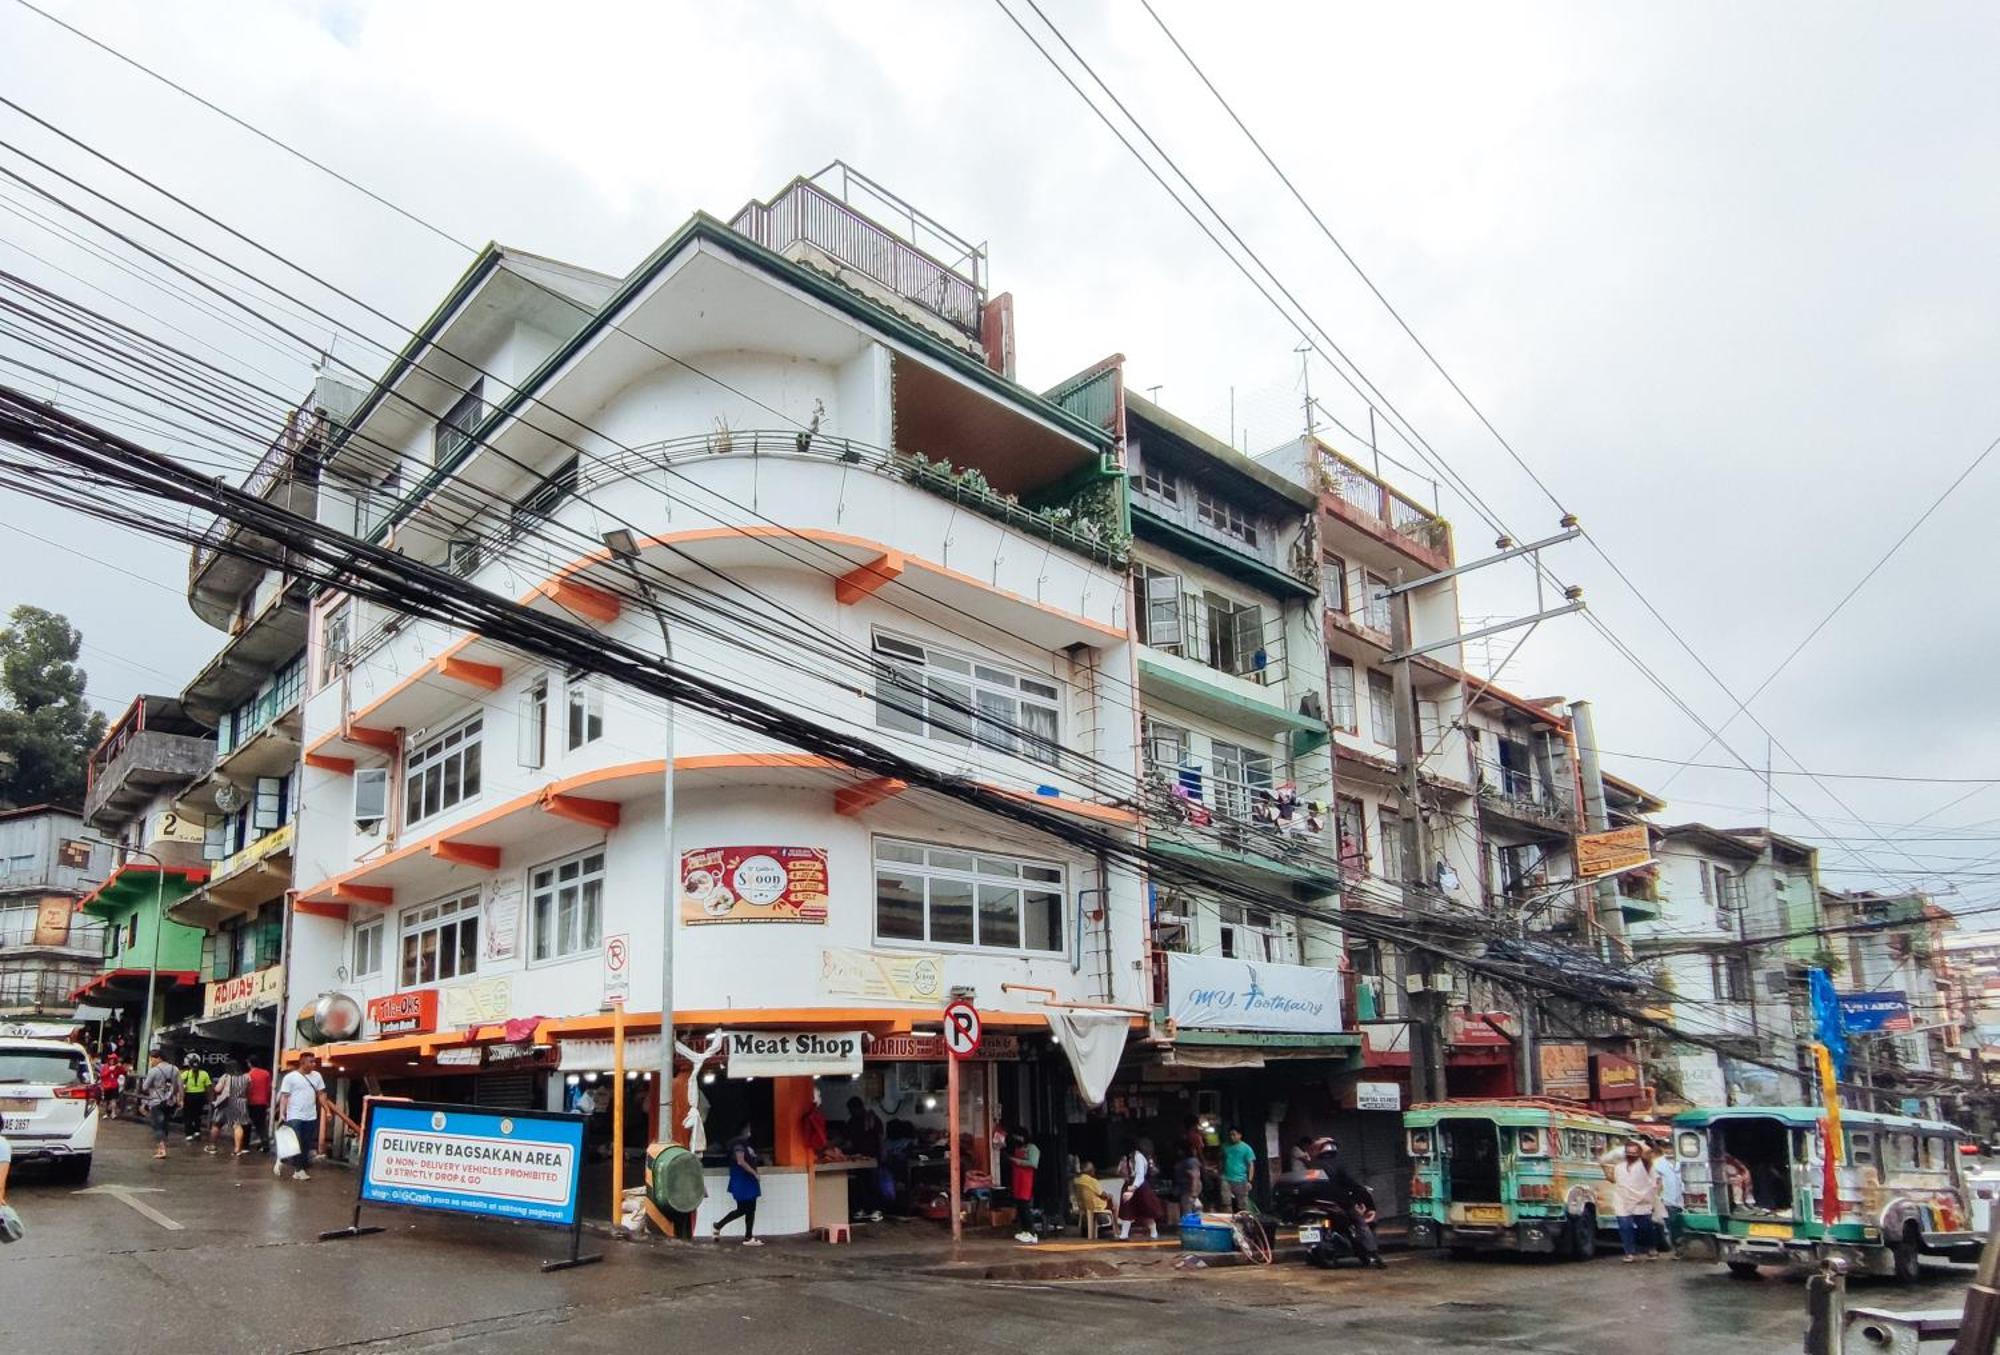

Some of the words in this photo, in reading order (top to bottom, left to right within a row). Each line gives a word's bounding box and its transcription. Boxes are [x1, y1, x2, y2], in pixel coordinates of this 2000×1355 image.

[163, 814, 177, 835] 2
[734, 1034, 791, 1055] Meat
[795, 1034, 854, 1058] Shop
[382, 1138, 443, 1157] DELIVERY
[445, 1143, 522, 1163] BAGSAKAN
[525, 1151, 563, 1167] AREA
[393, 1168, 433, 1181] STRICTLY
[434, 1172, 459, 1184] DROP
[467, 1176, 481, 1185] GO
[420, 1159, 461, 1172] DELIVERY
[462, 1163, 505, 1177] VEHICLES
[505, 1168, 558, 1183] PROHIBITED
